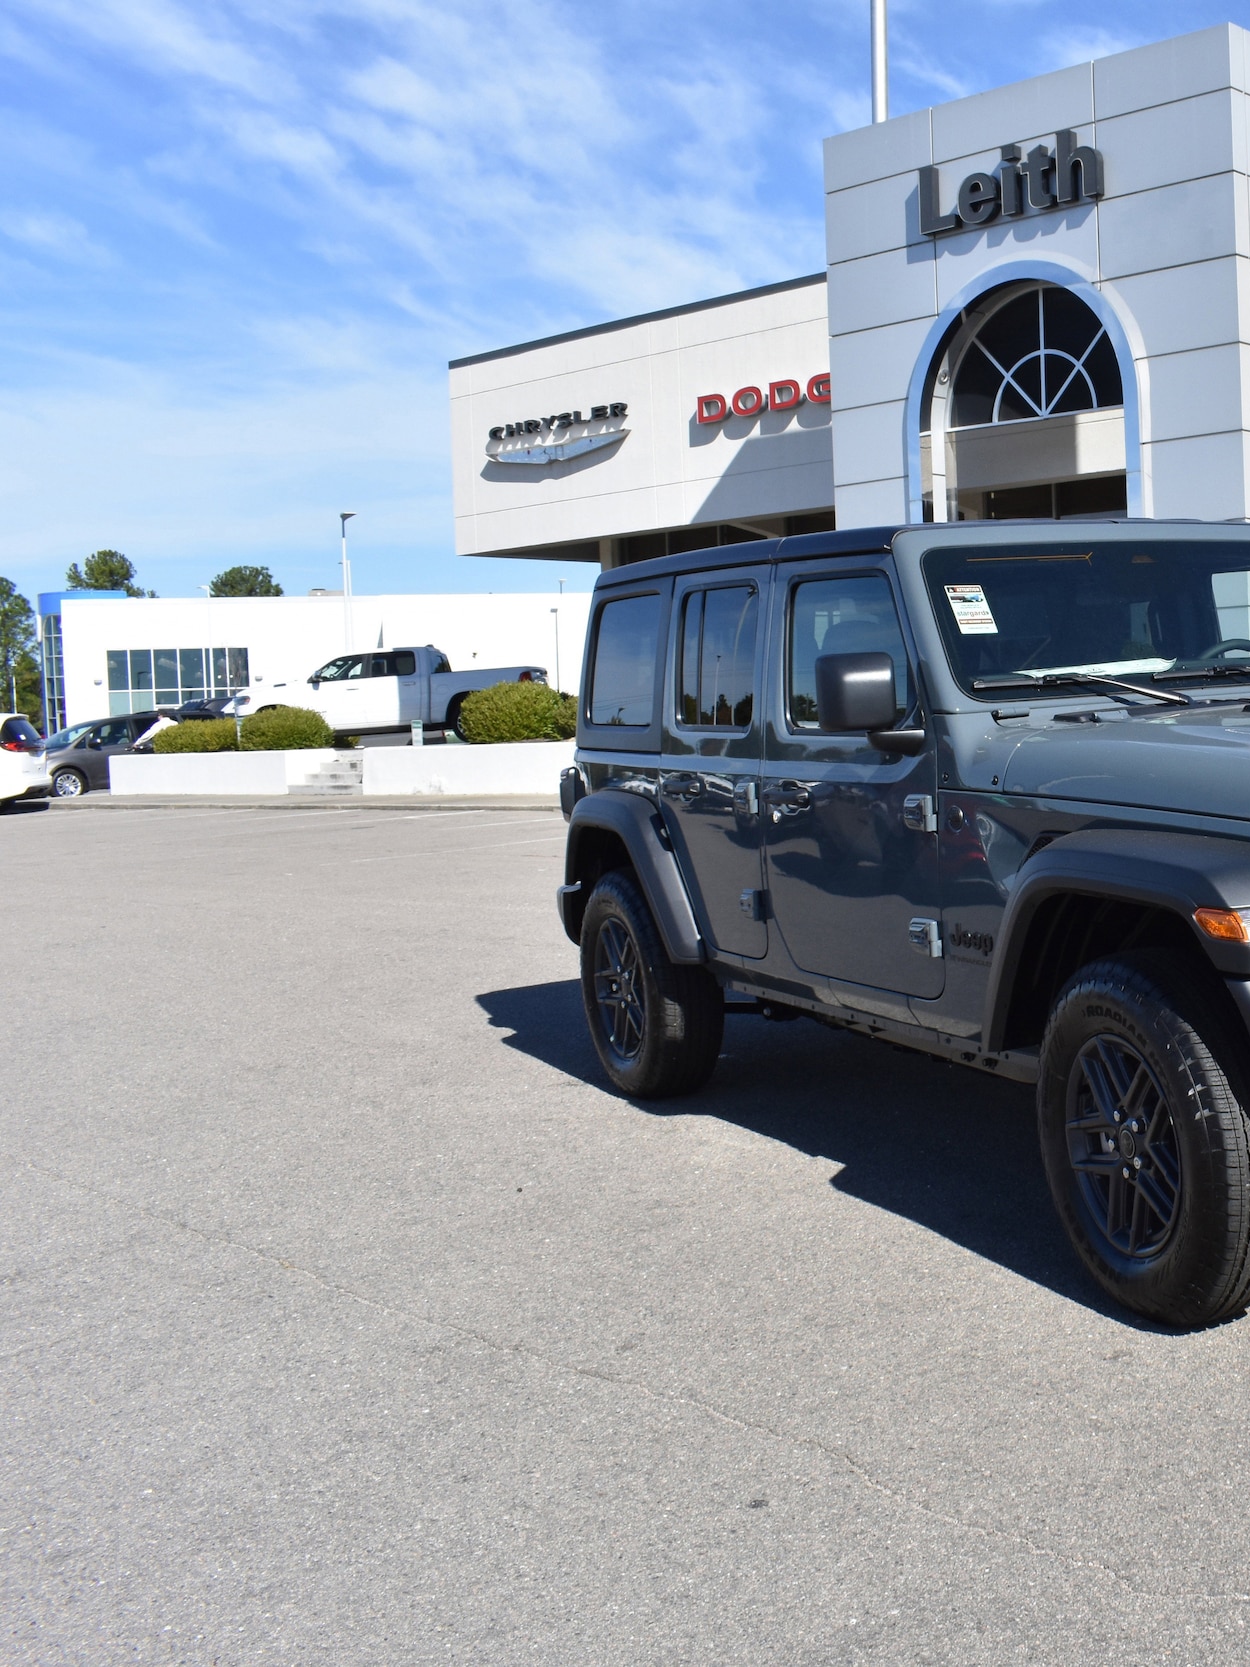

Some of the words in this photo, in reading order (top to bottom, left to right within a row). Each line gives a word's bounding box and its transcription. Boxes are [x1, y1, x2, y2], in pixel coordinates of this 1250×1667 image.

[918, 129, 1104, 236] Leith
[697, 372, 831, 424] DODG
[489, 402, 628, 440] CHRYSLER
[950, 923, 993, 957] Jeep
[1085, 1004, 1147, 1048] ROADIAN
